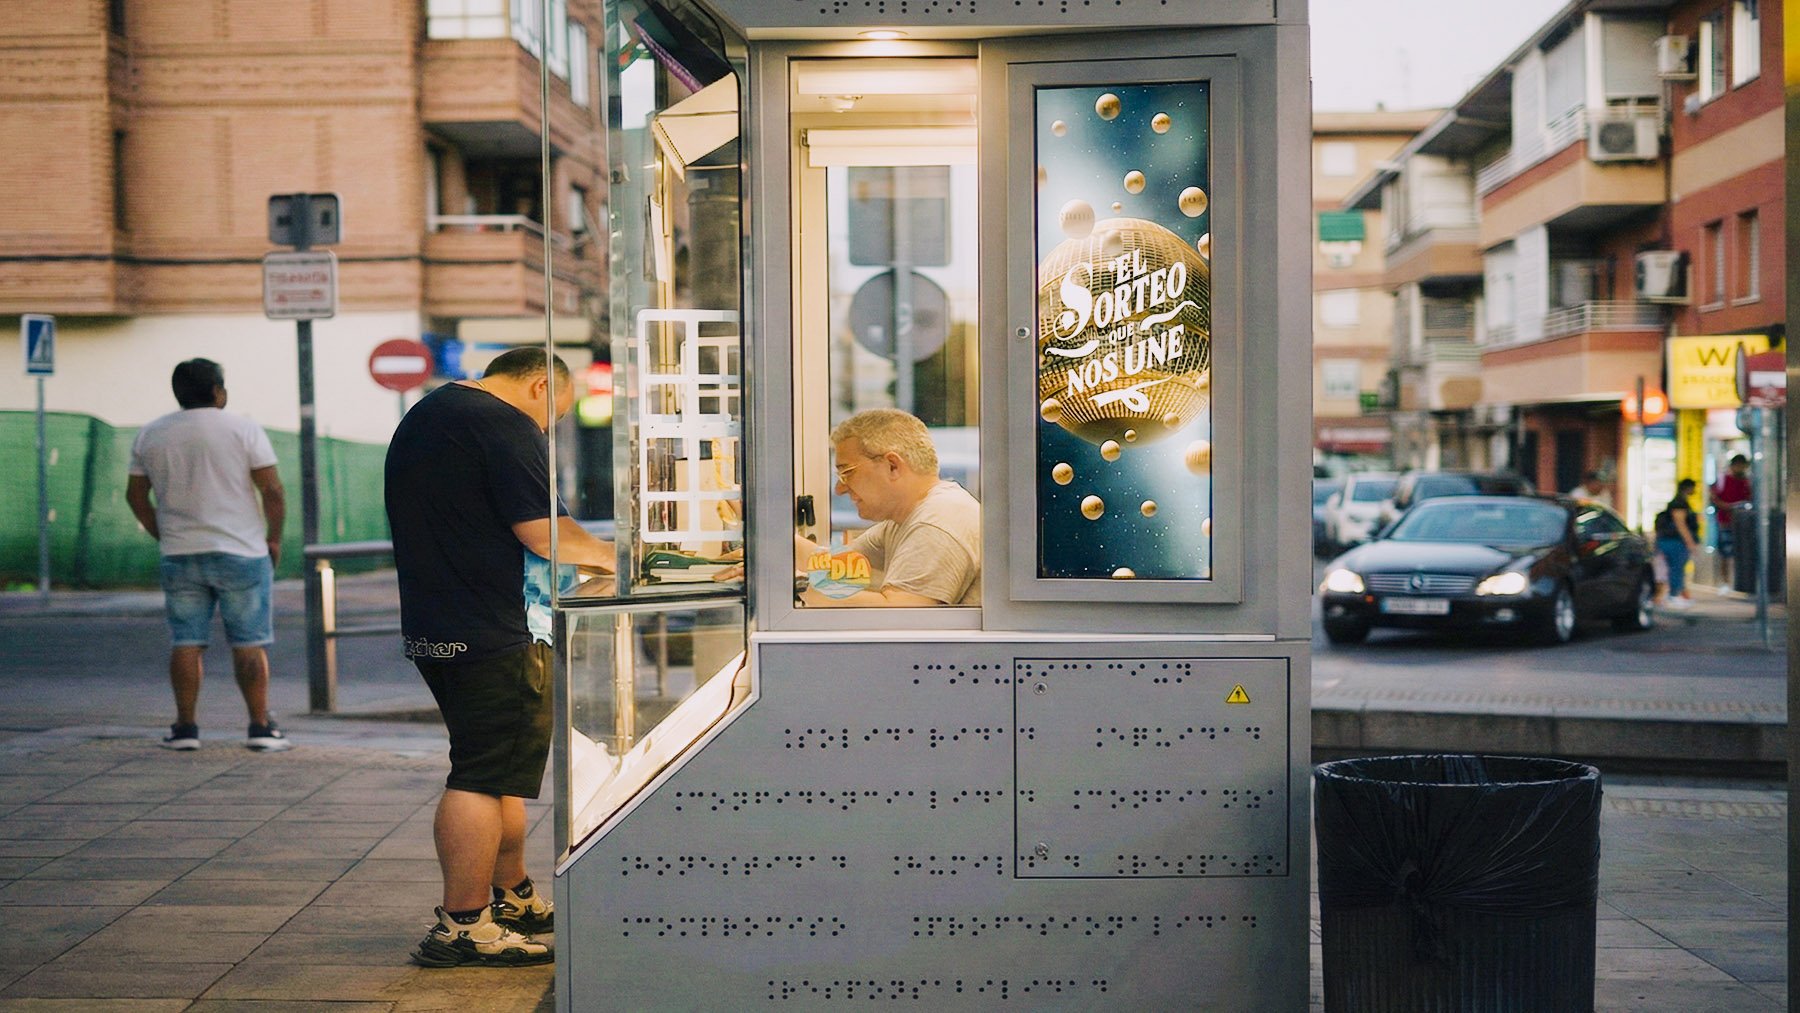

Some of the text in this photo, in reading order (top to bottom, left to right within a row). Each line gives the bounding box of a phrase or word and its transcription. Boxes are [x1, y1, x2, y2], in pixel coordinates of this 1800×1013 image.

[1109, 248, 1147, 285] EL
[1053, 261, 1187, 341] SORTEO
[1066, 323, 1185, 397] NOS UNE
[1108, 324, 1135, 345] QUE
